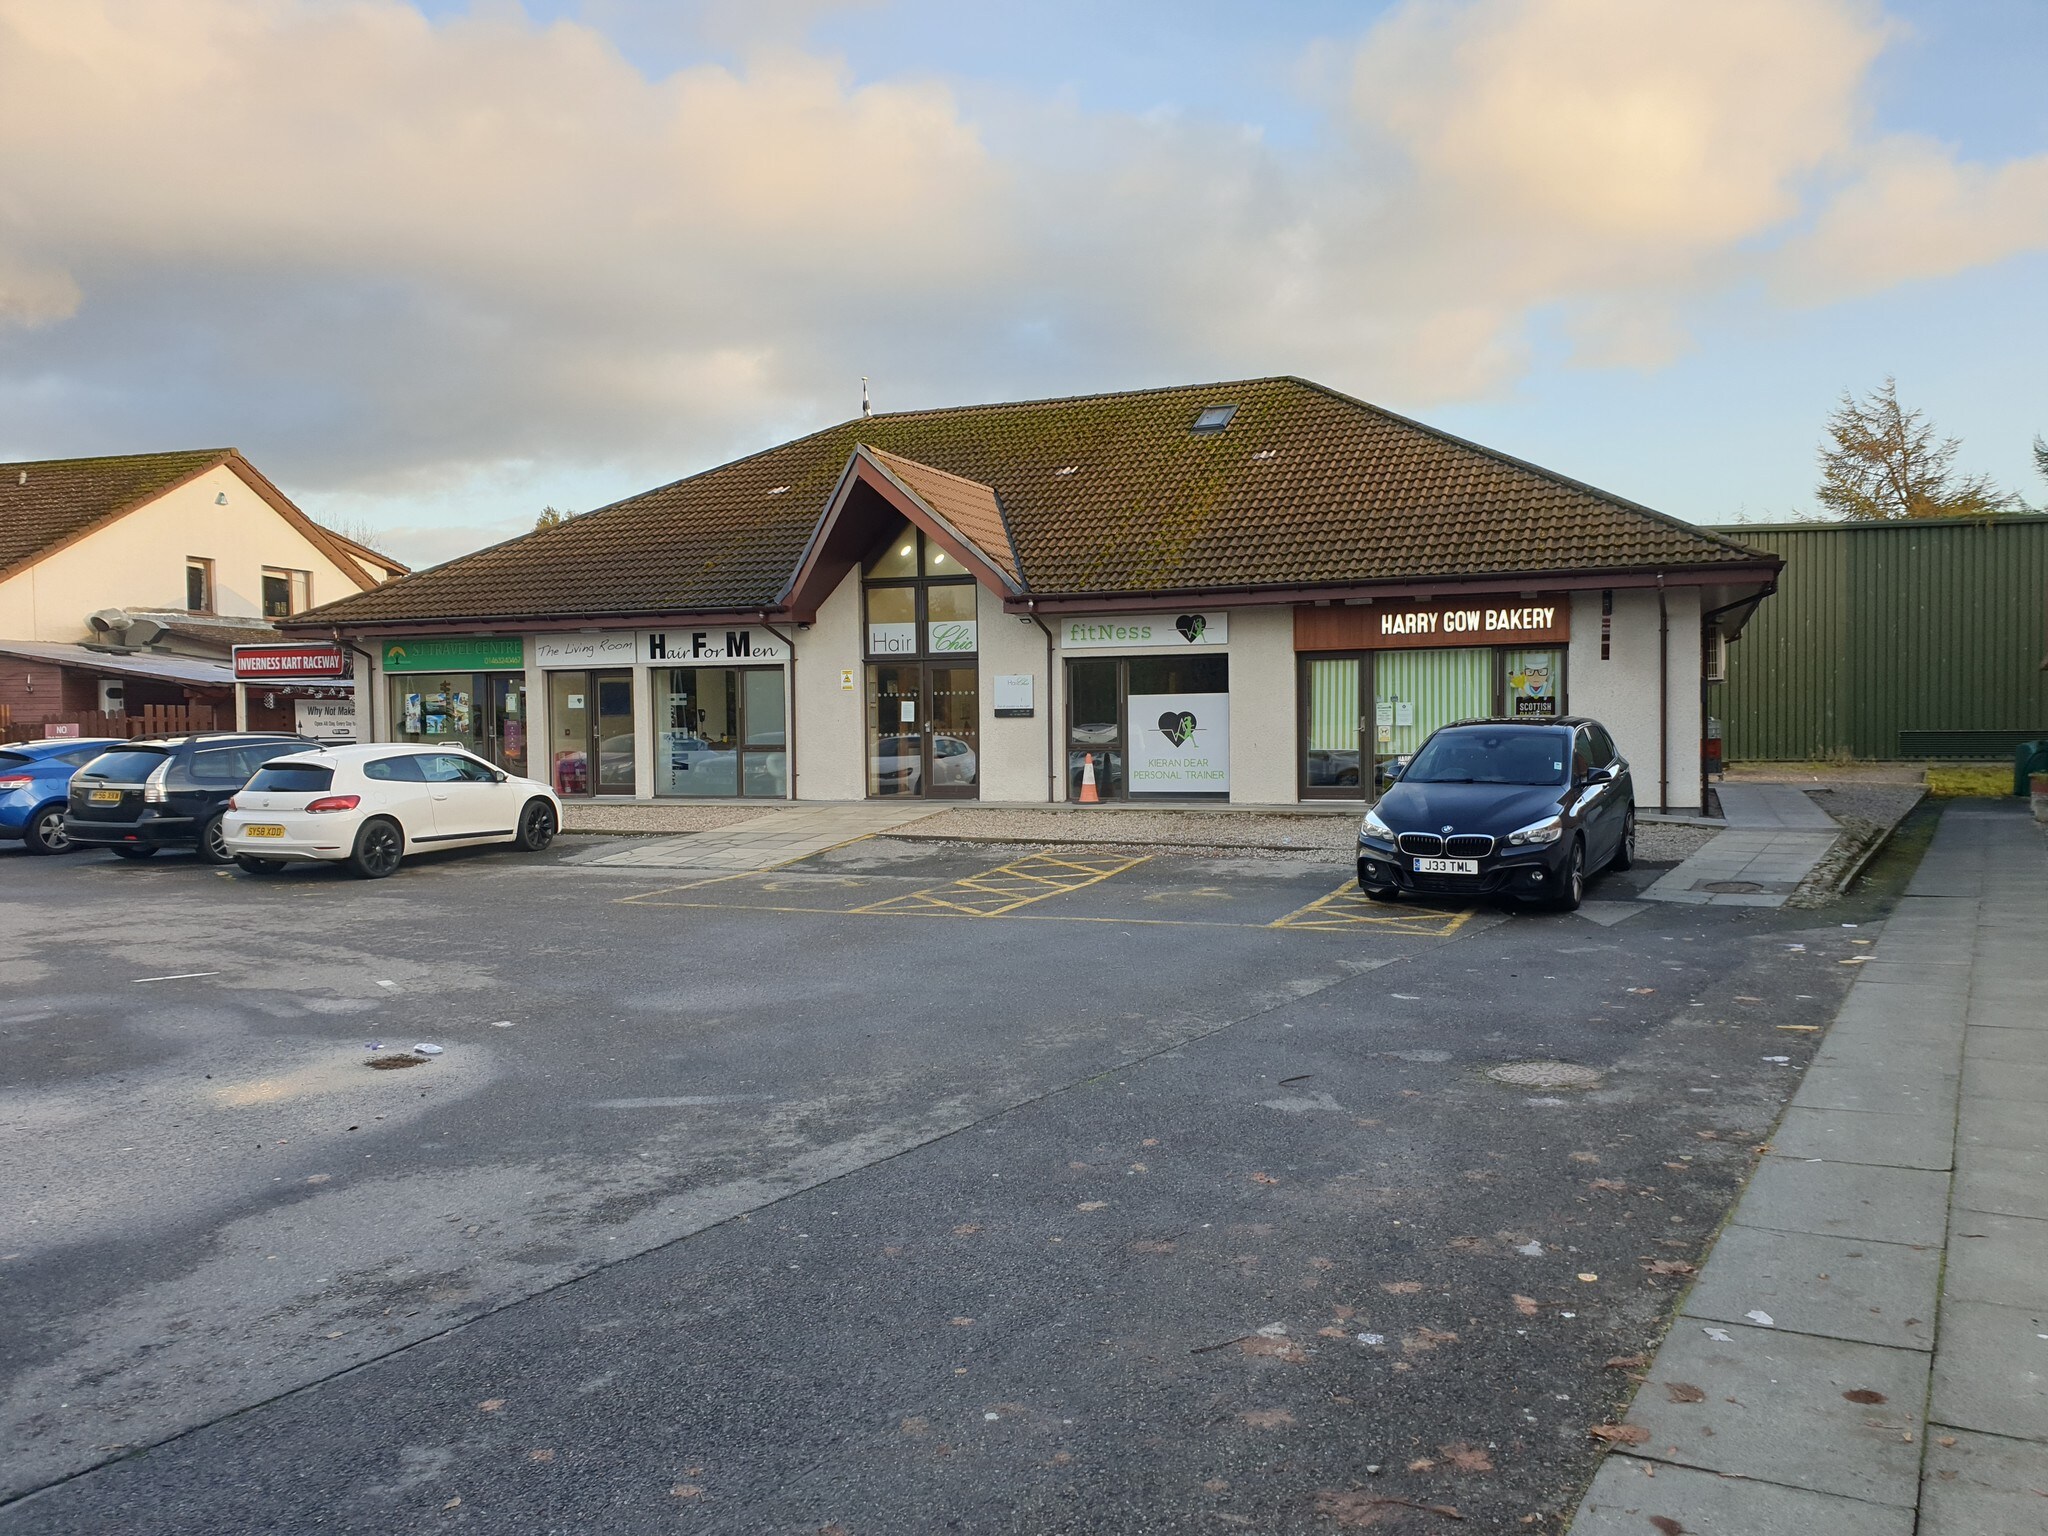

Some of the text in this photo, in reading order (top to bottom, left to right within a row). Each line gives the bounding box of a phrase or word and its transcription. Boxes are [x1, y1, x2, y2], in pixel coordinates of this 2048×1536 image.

[1381, 607, 1555, 634] HARRY GOW BAKERY
[872, 623, 973, 652] Hair Chic
[1070, 624, 1151, 641] fitNess
[412, 641, 521, 656] SJ TRAVEL CENTRE
[538, 638, 633, 658] The Living Room
[649, 631, 779, 660] Hair For Men
[238, 655, 340, 671] INVERNESS KART RACEWAY
[307, 706, 355, 718] Why Not Make
[1519, 702, 1552, 711] SCOTTISH
[56, 725, 68, 734] NO
[1148, 758, 1209, 768] KIERAN DEAR
[1133, 770, 1225, 780] PERSONAL TRAINER
[248, 827, 265, 836] SY58
[1425, 860, 1472, 873] J33 TML
